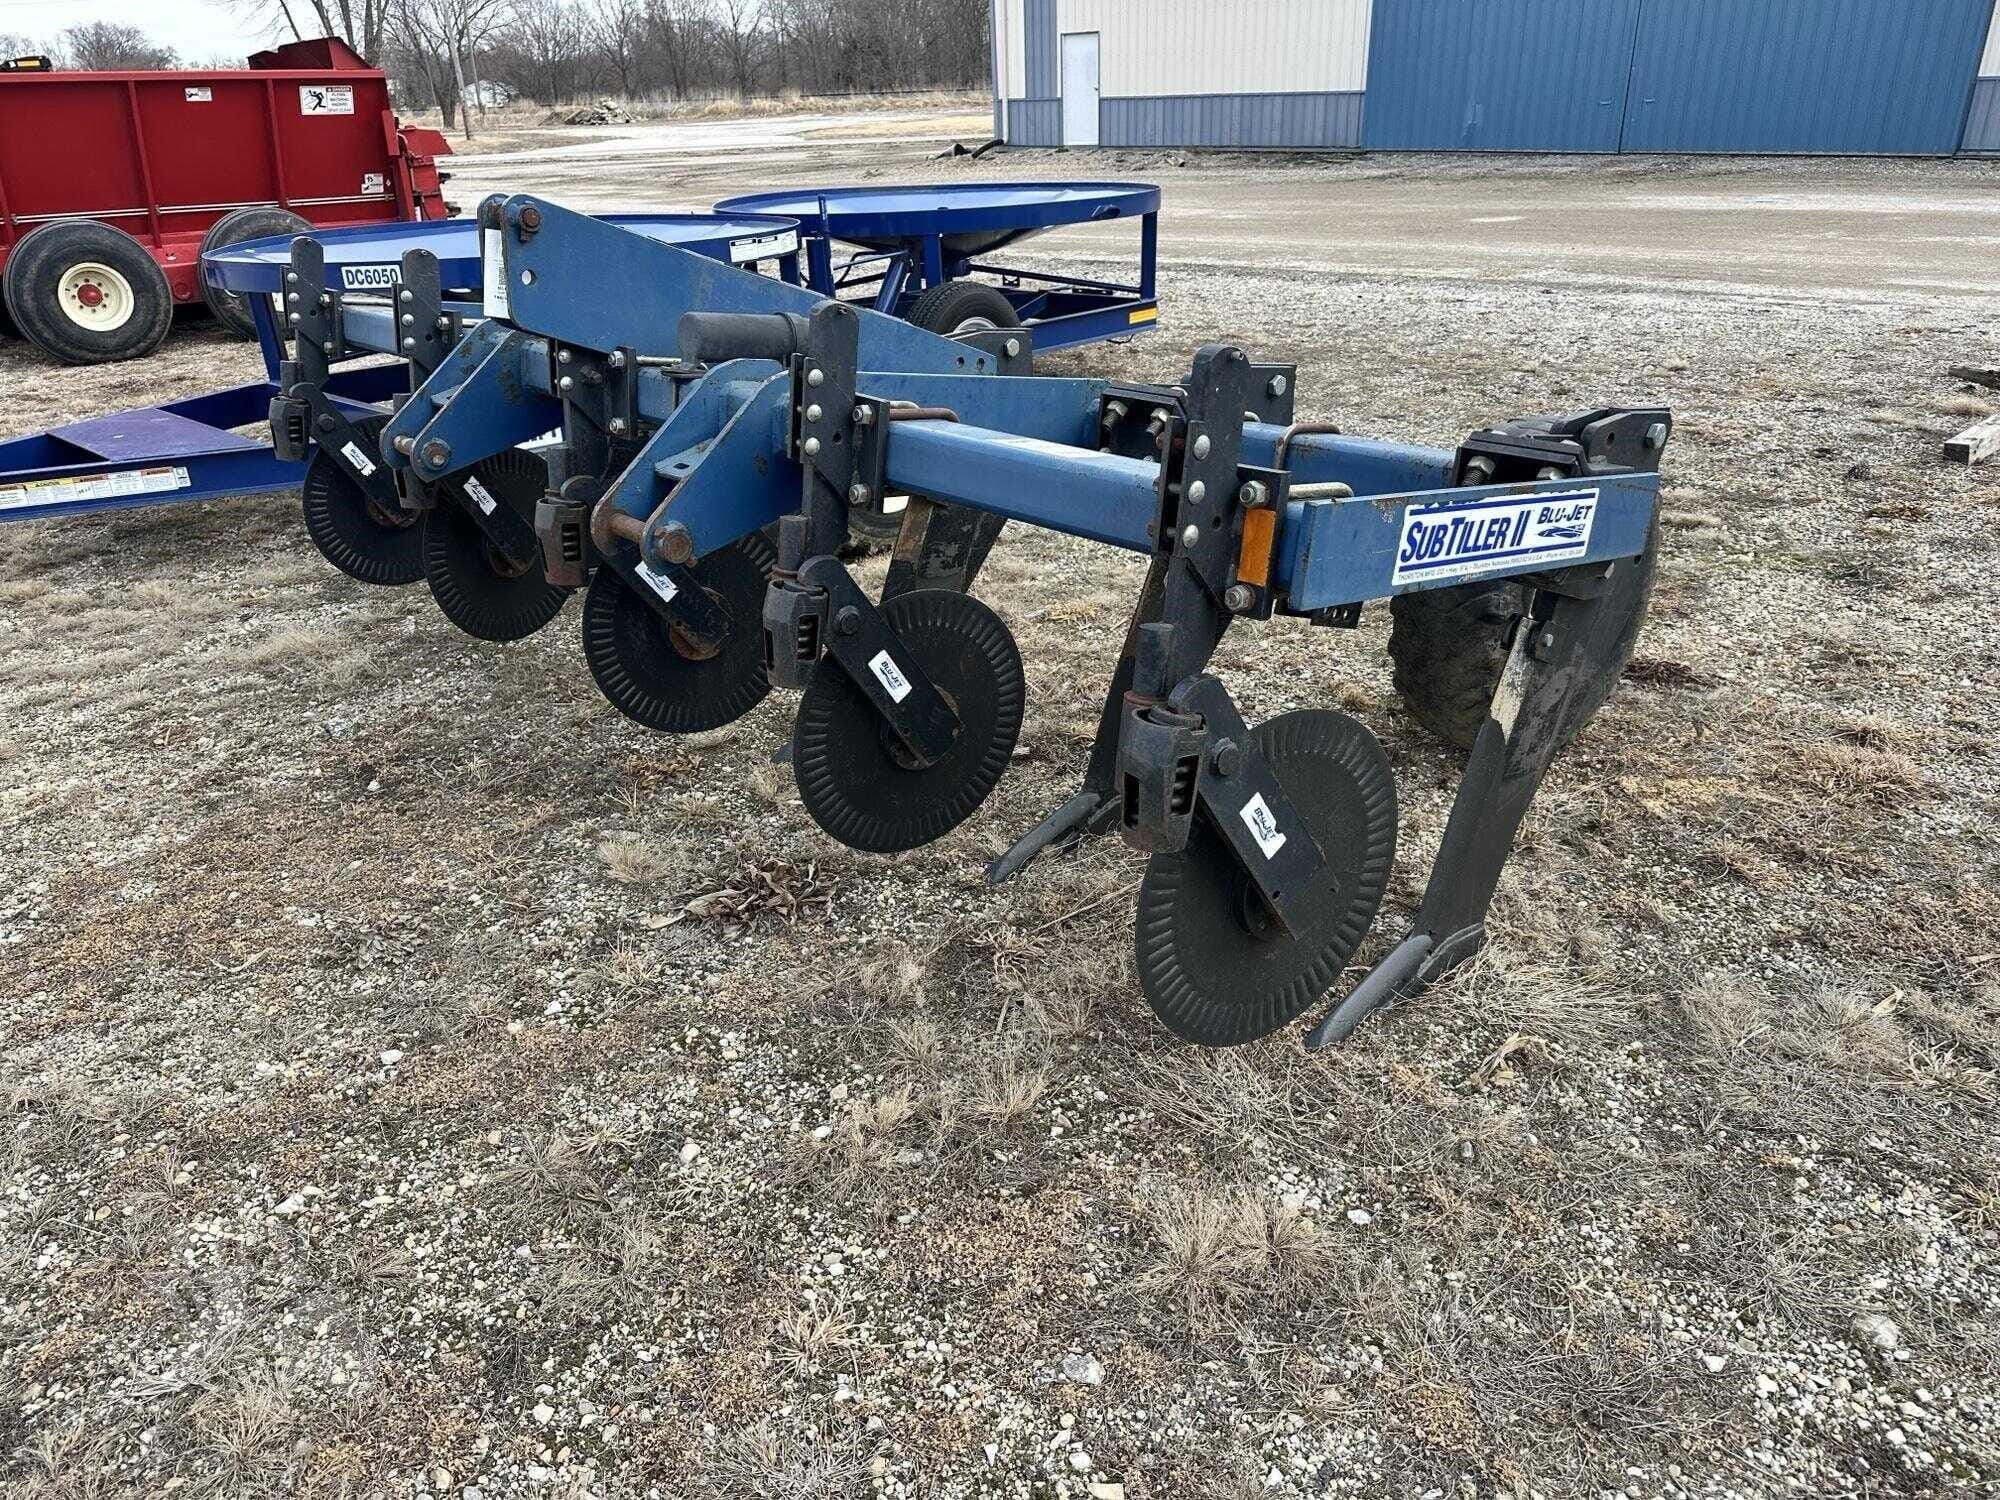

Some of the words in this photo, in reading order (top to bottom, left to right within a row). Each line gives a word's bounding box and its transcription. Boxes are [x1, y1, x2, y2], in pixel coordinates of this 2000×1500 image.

[345, 268, 398, 285] DC6050
[1537, 504, 1593, 524] BLU-JET
[1510, 510, 1531, 548] II
